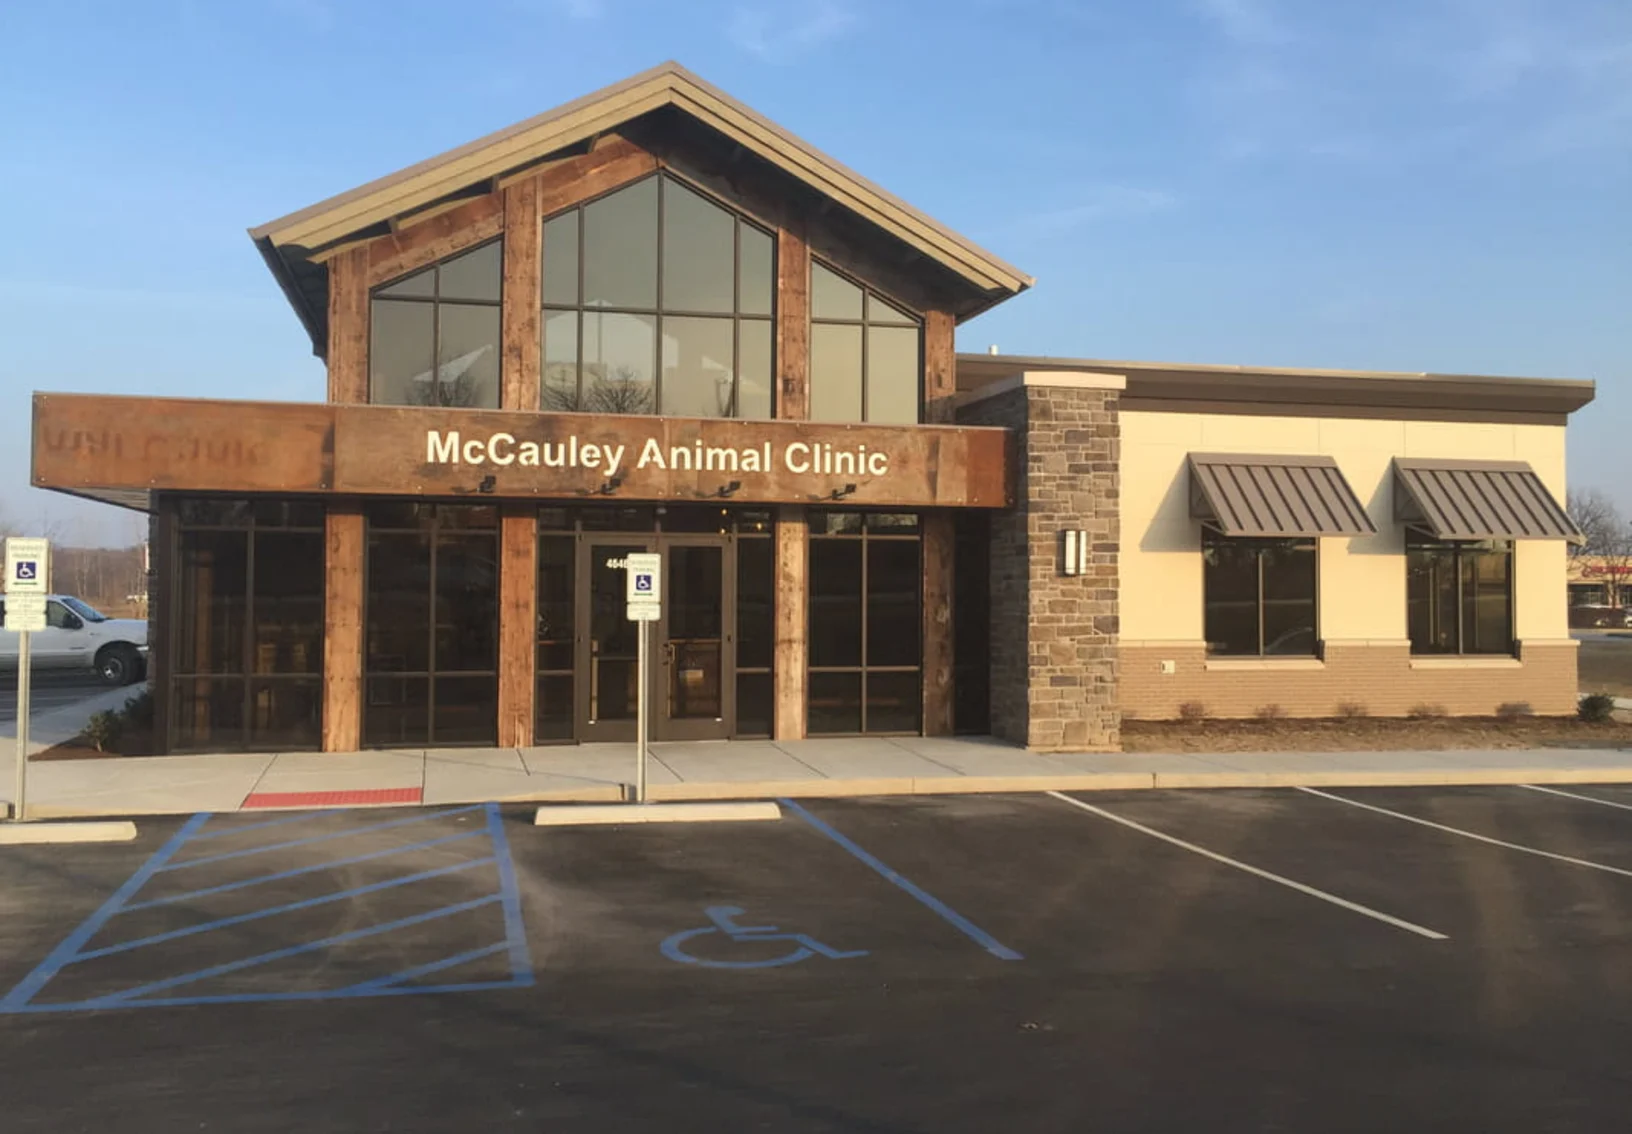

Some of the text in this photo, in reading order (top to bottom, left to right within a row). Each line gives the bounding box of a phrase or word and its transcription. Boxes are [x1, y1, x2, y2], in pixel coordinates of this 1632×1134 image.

[426, 430, 888, 476] McCauley Animal Clinic
